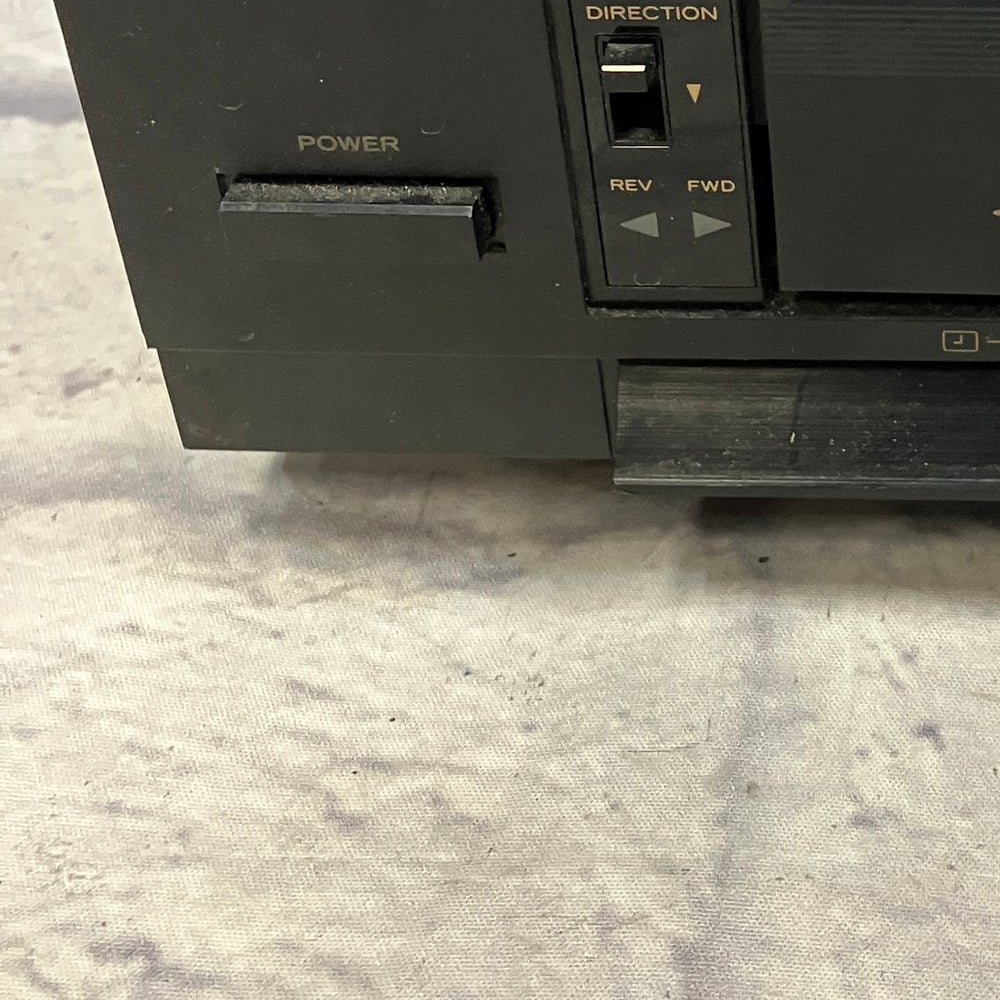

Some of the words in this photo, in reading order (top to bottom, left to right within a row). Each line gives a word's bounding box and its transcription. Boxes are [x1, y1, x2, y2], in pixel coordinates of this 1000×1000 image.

[586, 6, 718, 21] DIRECTION
[298, 135, 400, 152] POWER
[610, 179, 652, 192] REV
[687, 180, 736, 193] FWD
